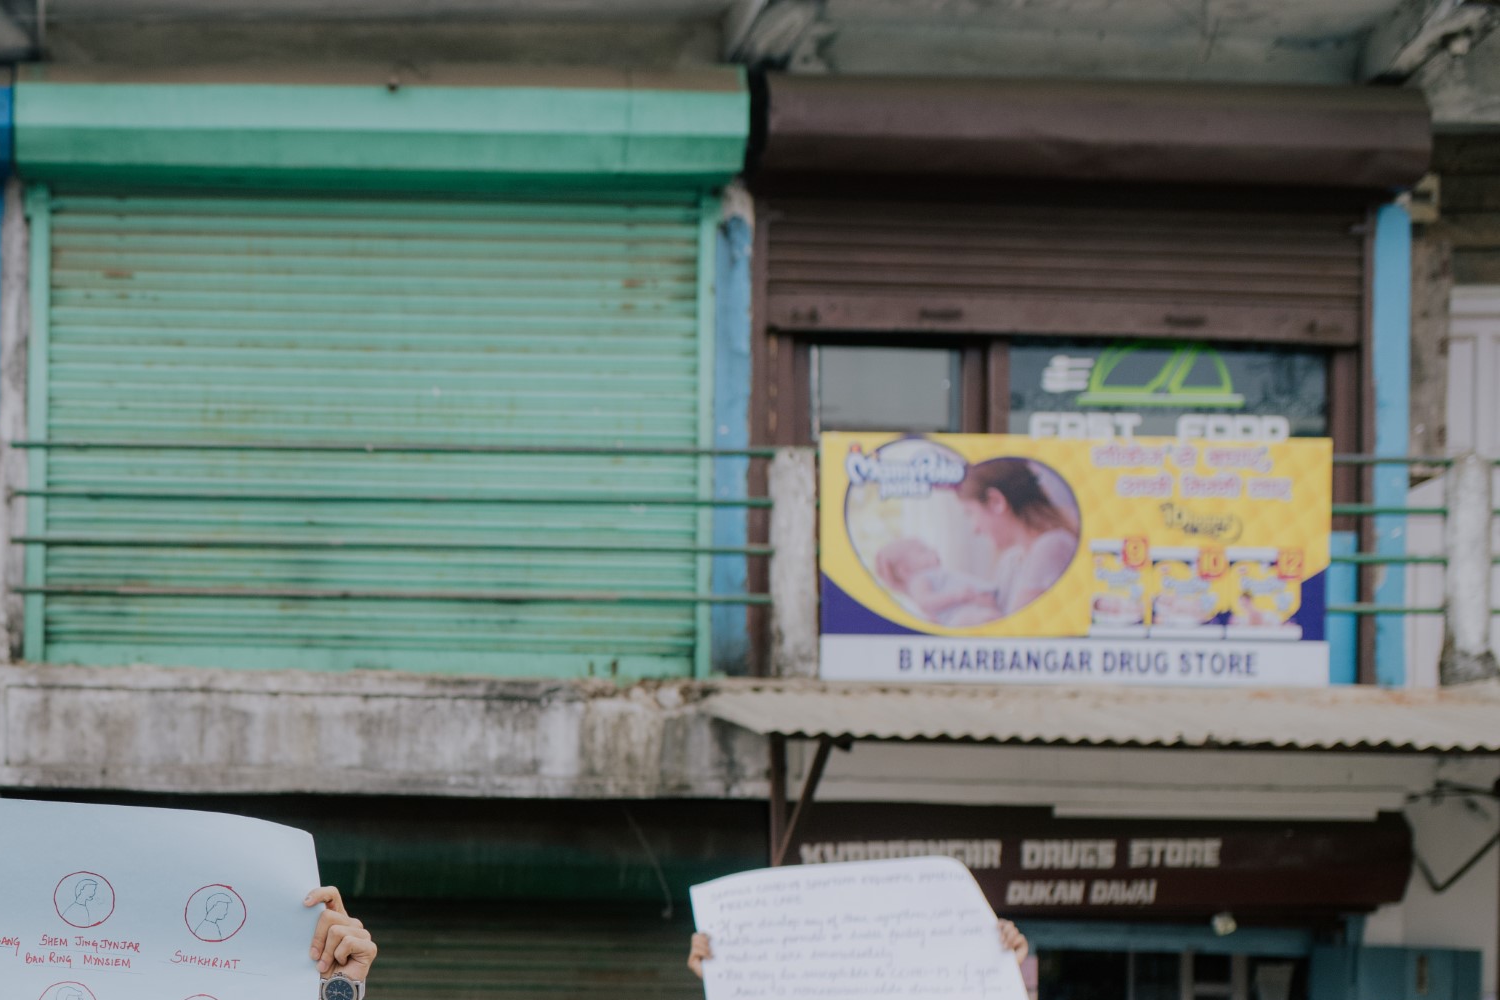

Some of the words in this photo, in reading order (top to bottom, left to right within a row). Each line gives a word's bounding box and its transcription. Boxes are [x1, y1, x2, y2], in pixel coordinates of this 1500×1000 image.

[1030, 412, 1142, 440] FAST
[1176, 413, 1290, 443] FOOD
[898, 647, 914, 672] B
[922, 648, 1094, 674] KHARBANGAR
[1102, 650, 1171, 675] DRUG
[1178, 651, 1259, 677] STORE
[1020, 839, 1117, 870] DRUGS
[1128, 838, 1222, 868] STORE
[1006, 880, 1085, 906] DUKAN
[39, 934, 69, 948] SHEM
[25, 953, 45, 966] BAN
[48, 952, 72, 968] RING
[83, 954, 131, 969] MYNSIEM
